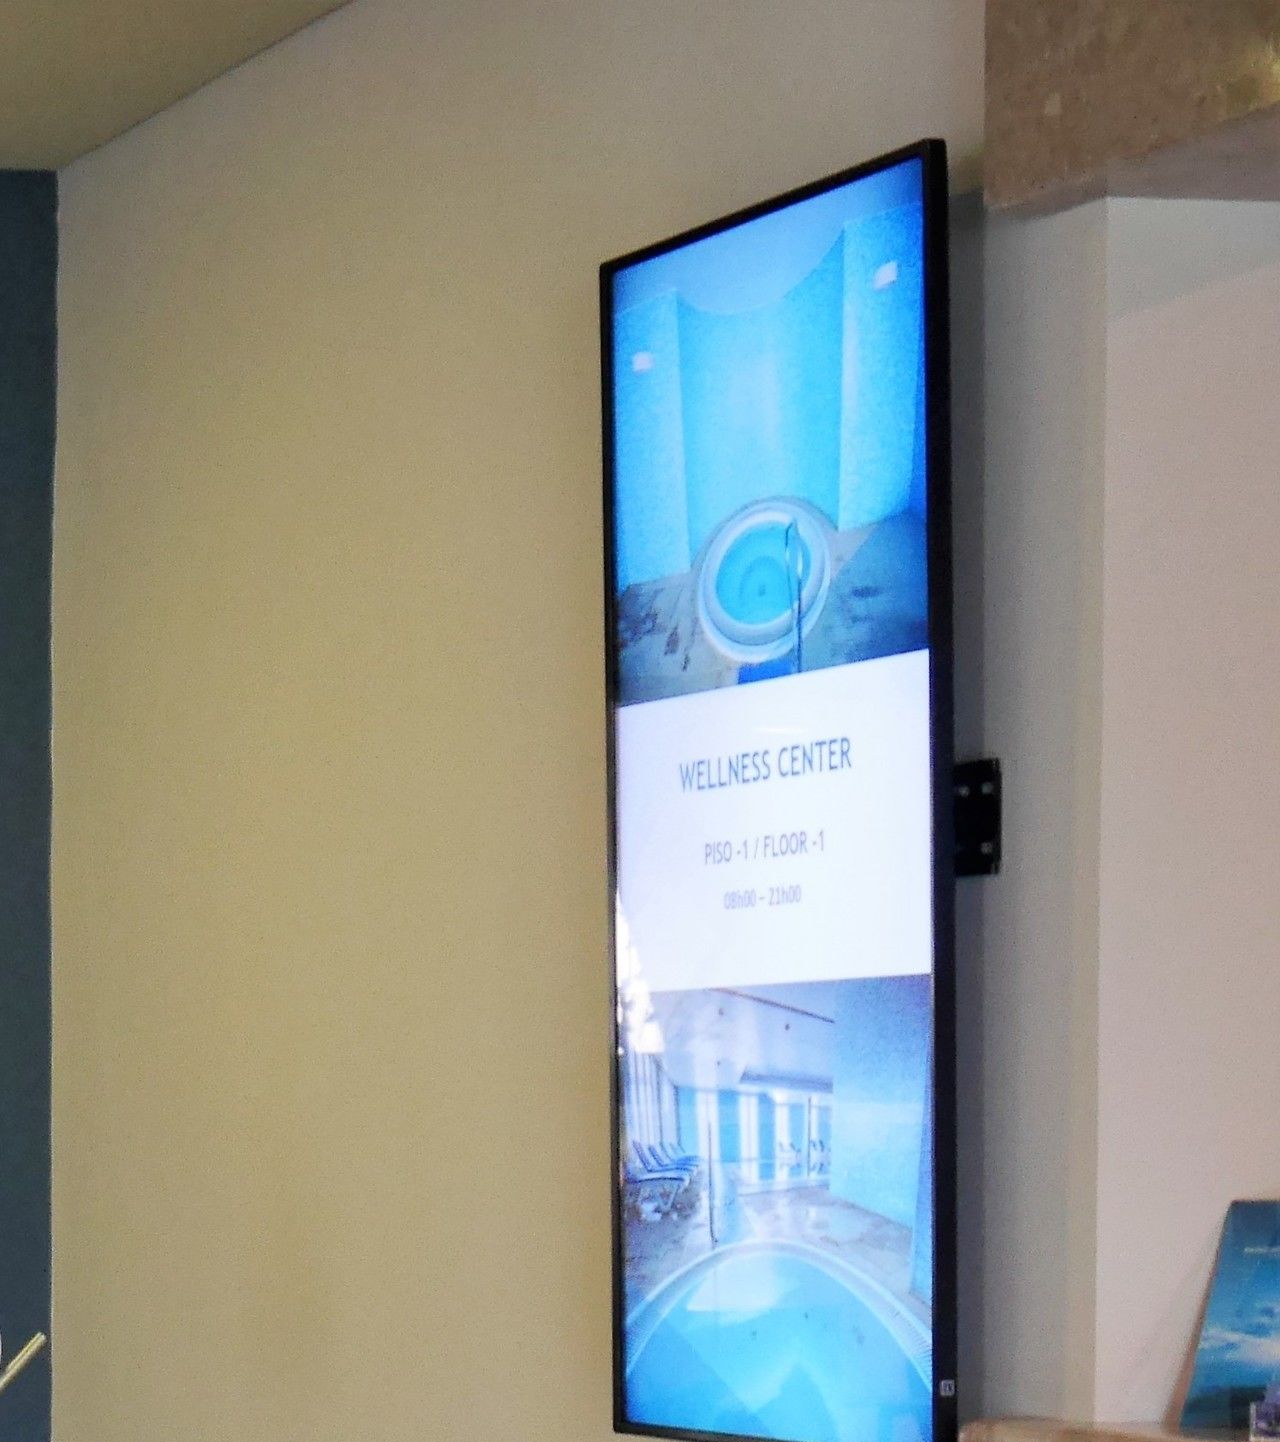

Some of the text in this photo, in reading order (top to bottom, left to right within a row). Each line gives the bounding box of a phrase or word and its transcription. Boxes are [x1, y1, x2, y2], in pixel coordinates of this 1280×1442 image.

[680, 737, 852, 793] WELLNESS CENTER
[704, 841, 733, 865] PISO
[736, 839, 749, 861] -1
[763, 831, 808, 858] FLOOR
[812, 829, 825, 852] -1
[768, 885, 802, 906] 21h00
